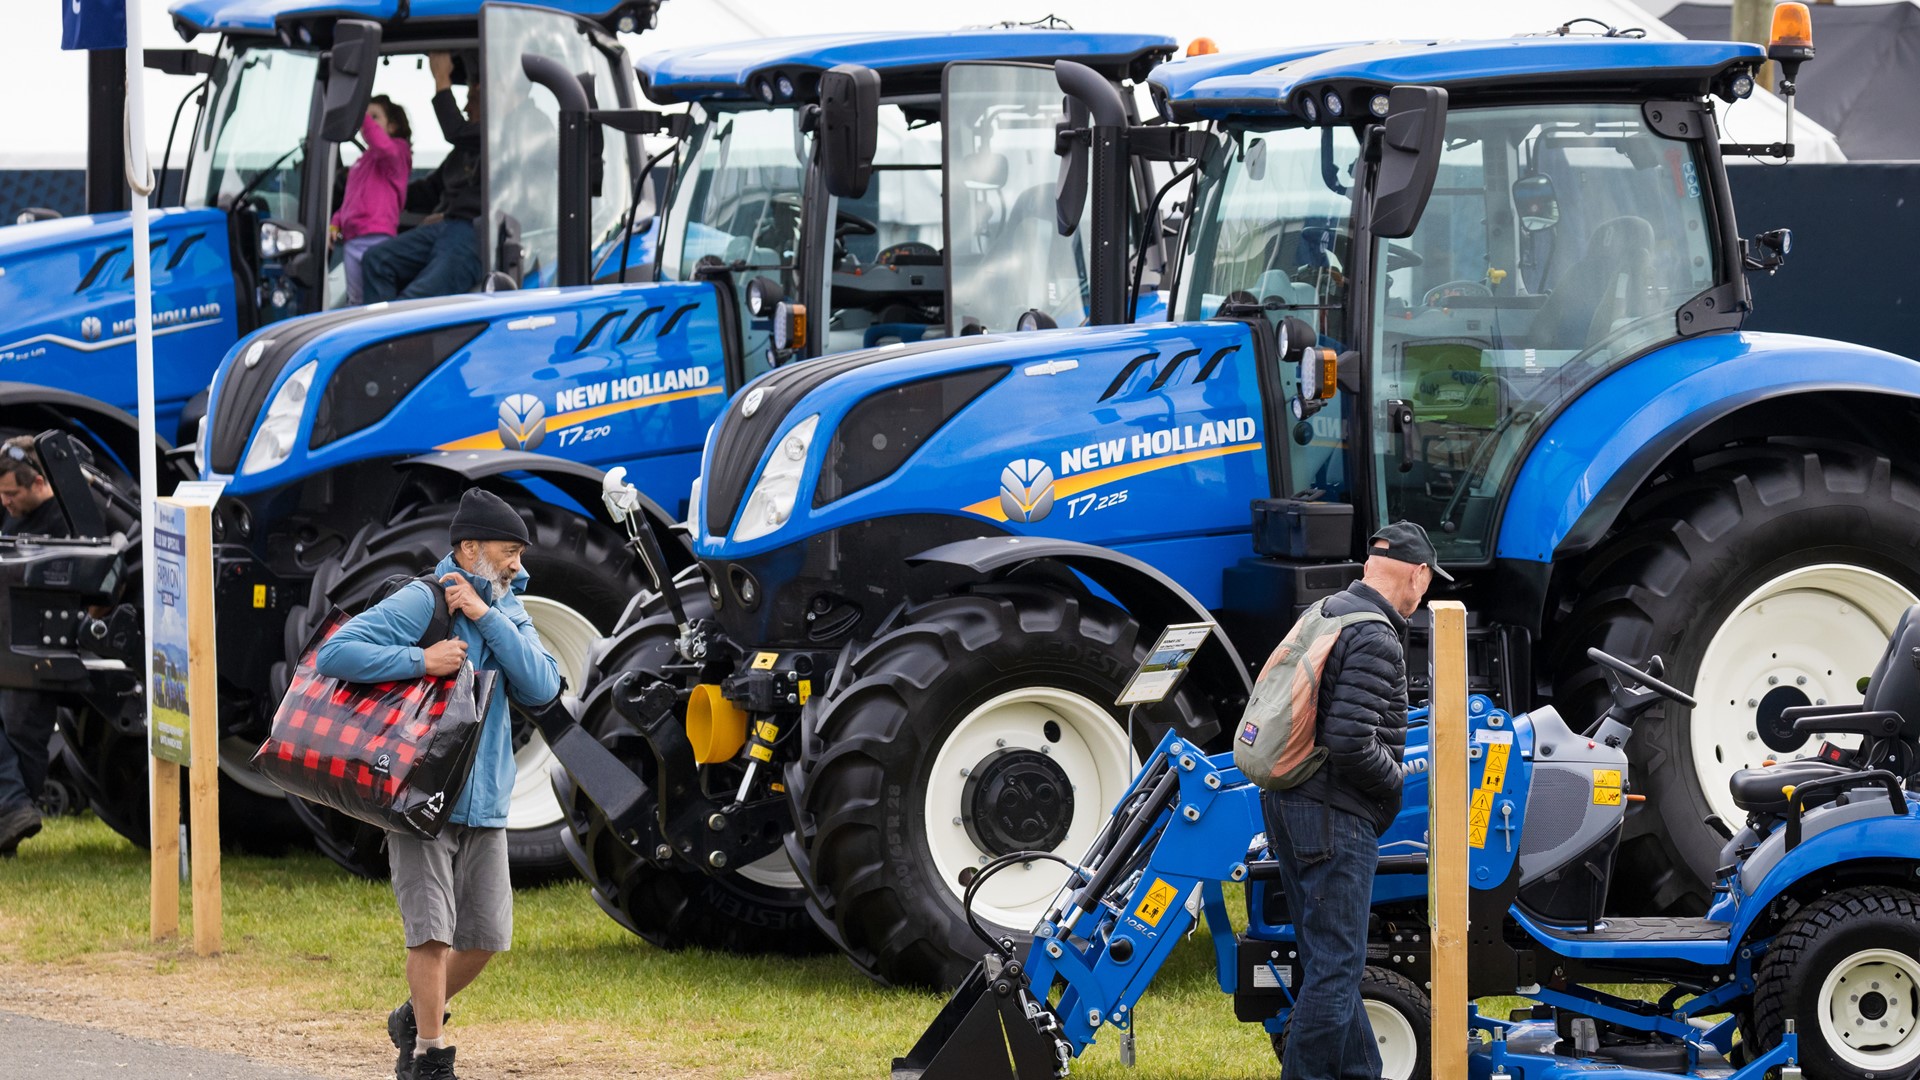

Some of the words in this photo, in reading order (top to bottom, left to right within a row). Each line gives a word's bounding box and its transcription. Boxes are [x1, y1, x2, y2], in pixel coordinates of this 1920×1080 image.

[113, 319, 137, 335] NE
[152, 302, 221, 326] HOLLAND
[1525, 348, 1536, 367] PLM
[556, 382, 607, 413] NEW
[611, 366, 709, 400] HOLLAND
[558, 425, 611, 448] T7.270
[1061, 437, 1126, 475] NEW
[1131, 417, 1255, 460] HOLLAND
[1067, 490, 1128, 519] T7.225
